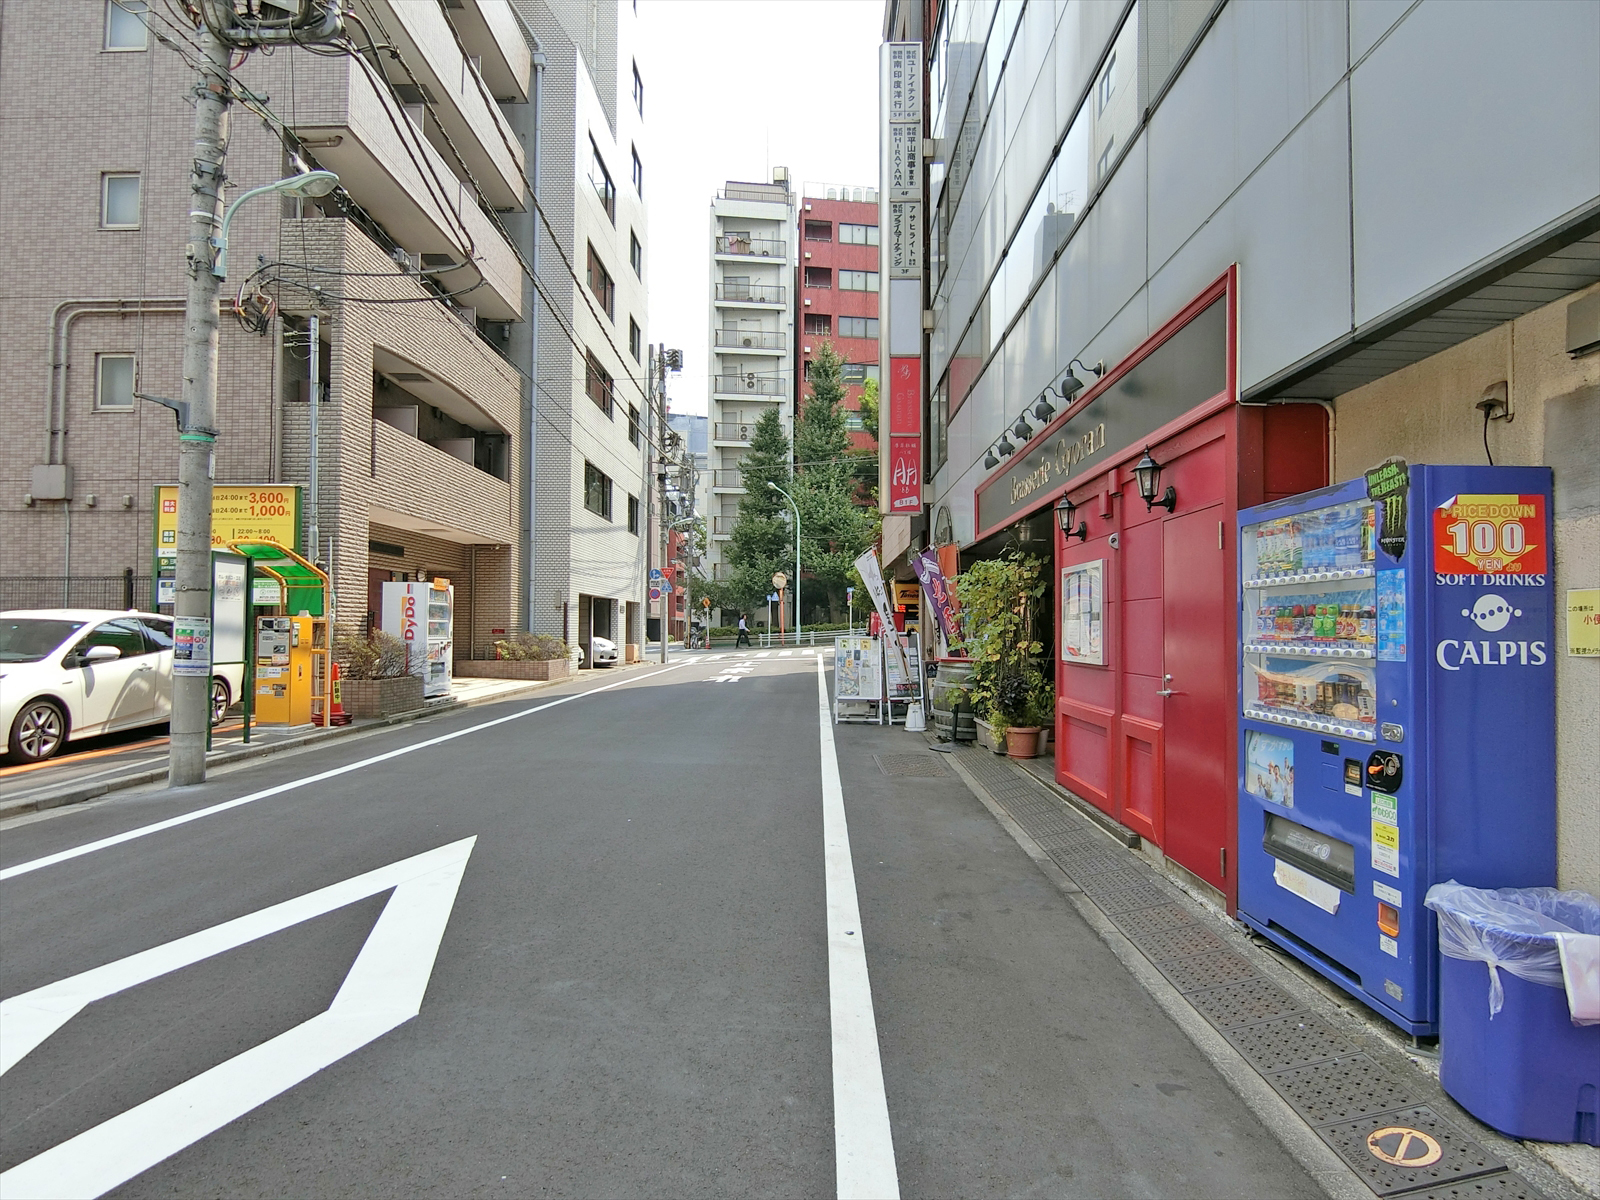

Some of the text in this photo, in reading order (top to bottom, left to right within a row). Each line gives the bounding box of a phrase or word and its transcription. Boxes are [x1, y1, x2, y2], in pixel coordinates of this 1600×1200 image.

[907, 60, 916, 109] ユーアイテクノ
[894, 137, 902, 187] HIRAYAMA
[1054, 422, 1107, 476] Gyoran
[1009, 456, 1051, 505] Brasserie
[1371, 485, 1382, 497] THE
[1440, 504, 1536, 518] PRICE DOWN
[1446, 519, 1525, 557] 100
[1436, 573, 1546, 586] SOFT DRINKS
[1475, 557, 1503, 571] YEN
[404, 596, 419, 640] DyDo
[1436, 639, 1547, 671] CALPIS
